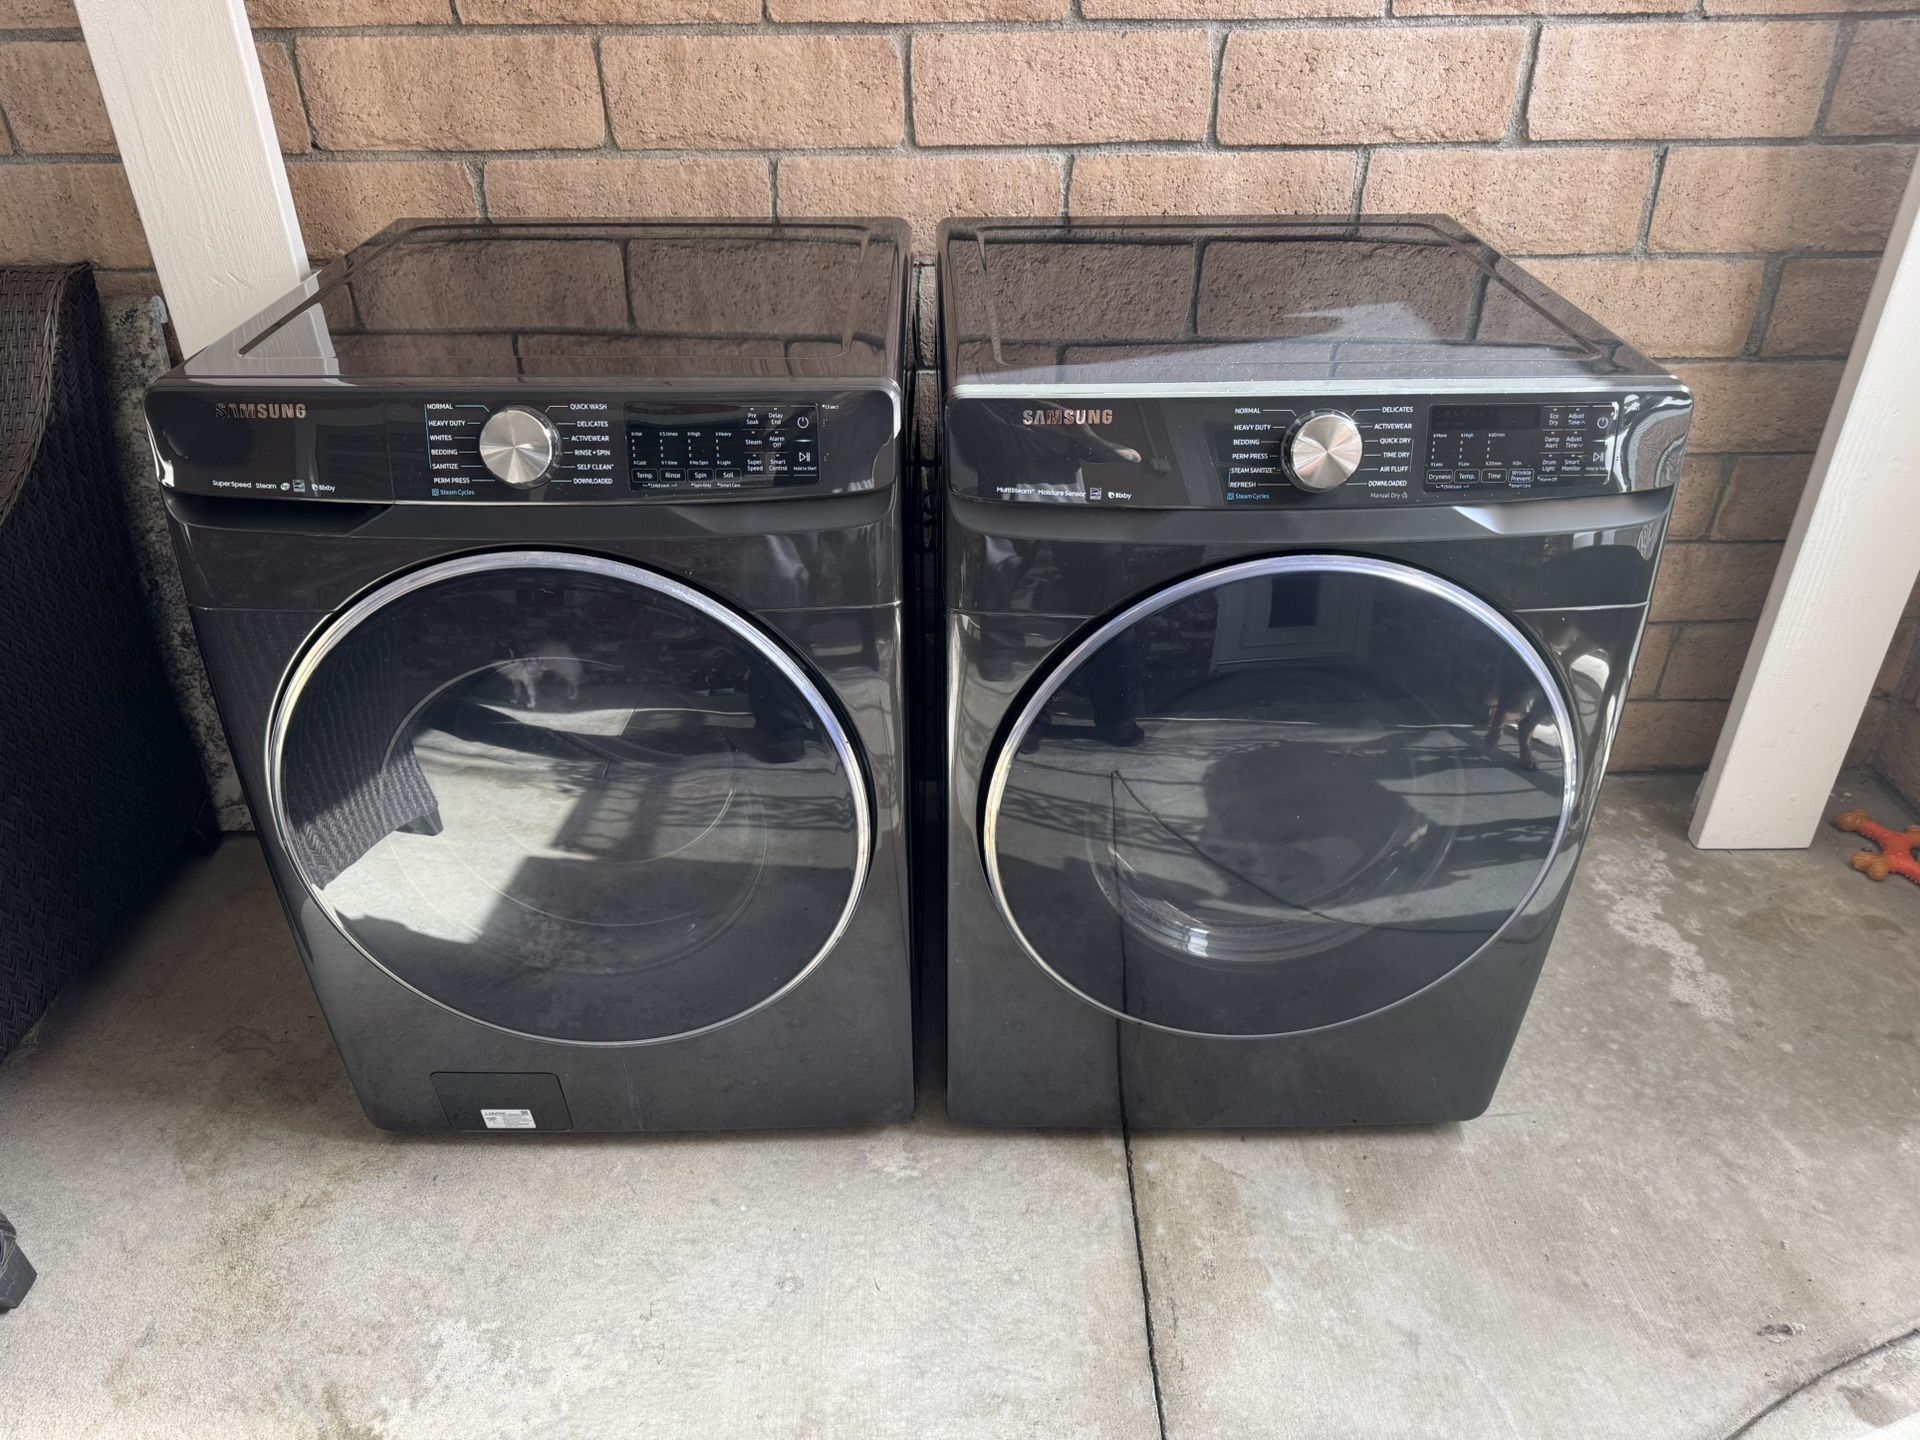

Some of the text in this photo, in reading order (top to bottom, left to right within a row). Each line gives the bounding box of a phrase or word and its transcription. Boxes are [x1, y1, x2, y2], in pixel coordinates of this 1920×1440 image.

[215, 402, 307, 418] SAMSUNG
[1022, 409, 1113, 424] SAMSUNG
[458, 489, 474, 497] Cycles
[1038, 489, 1064, 497] Moisture
[1252, 492, 1270, 500] Cycles
[1390, 492, 1400, 500] Dry
